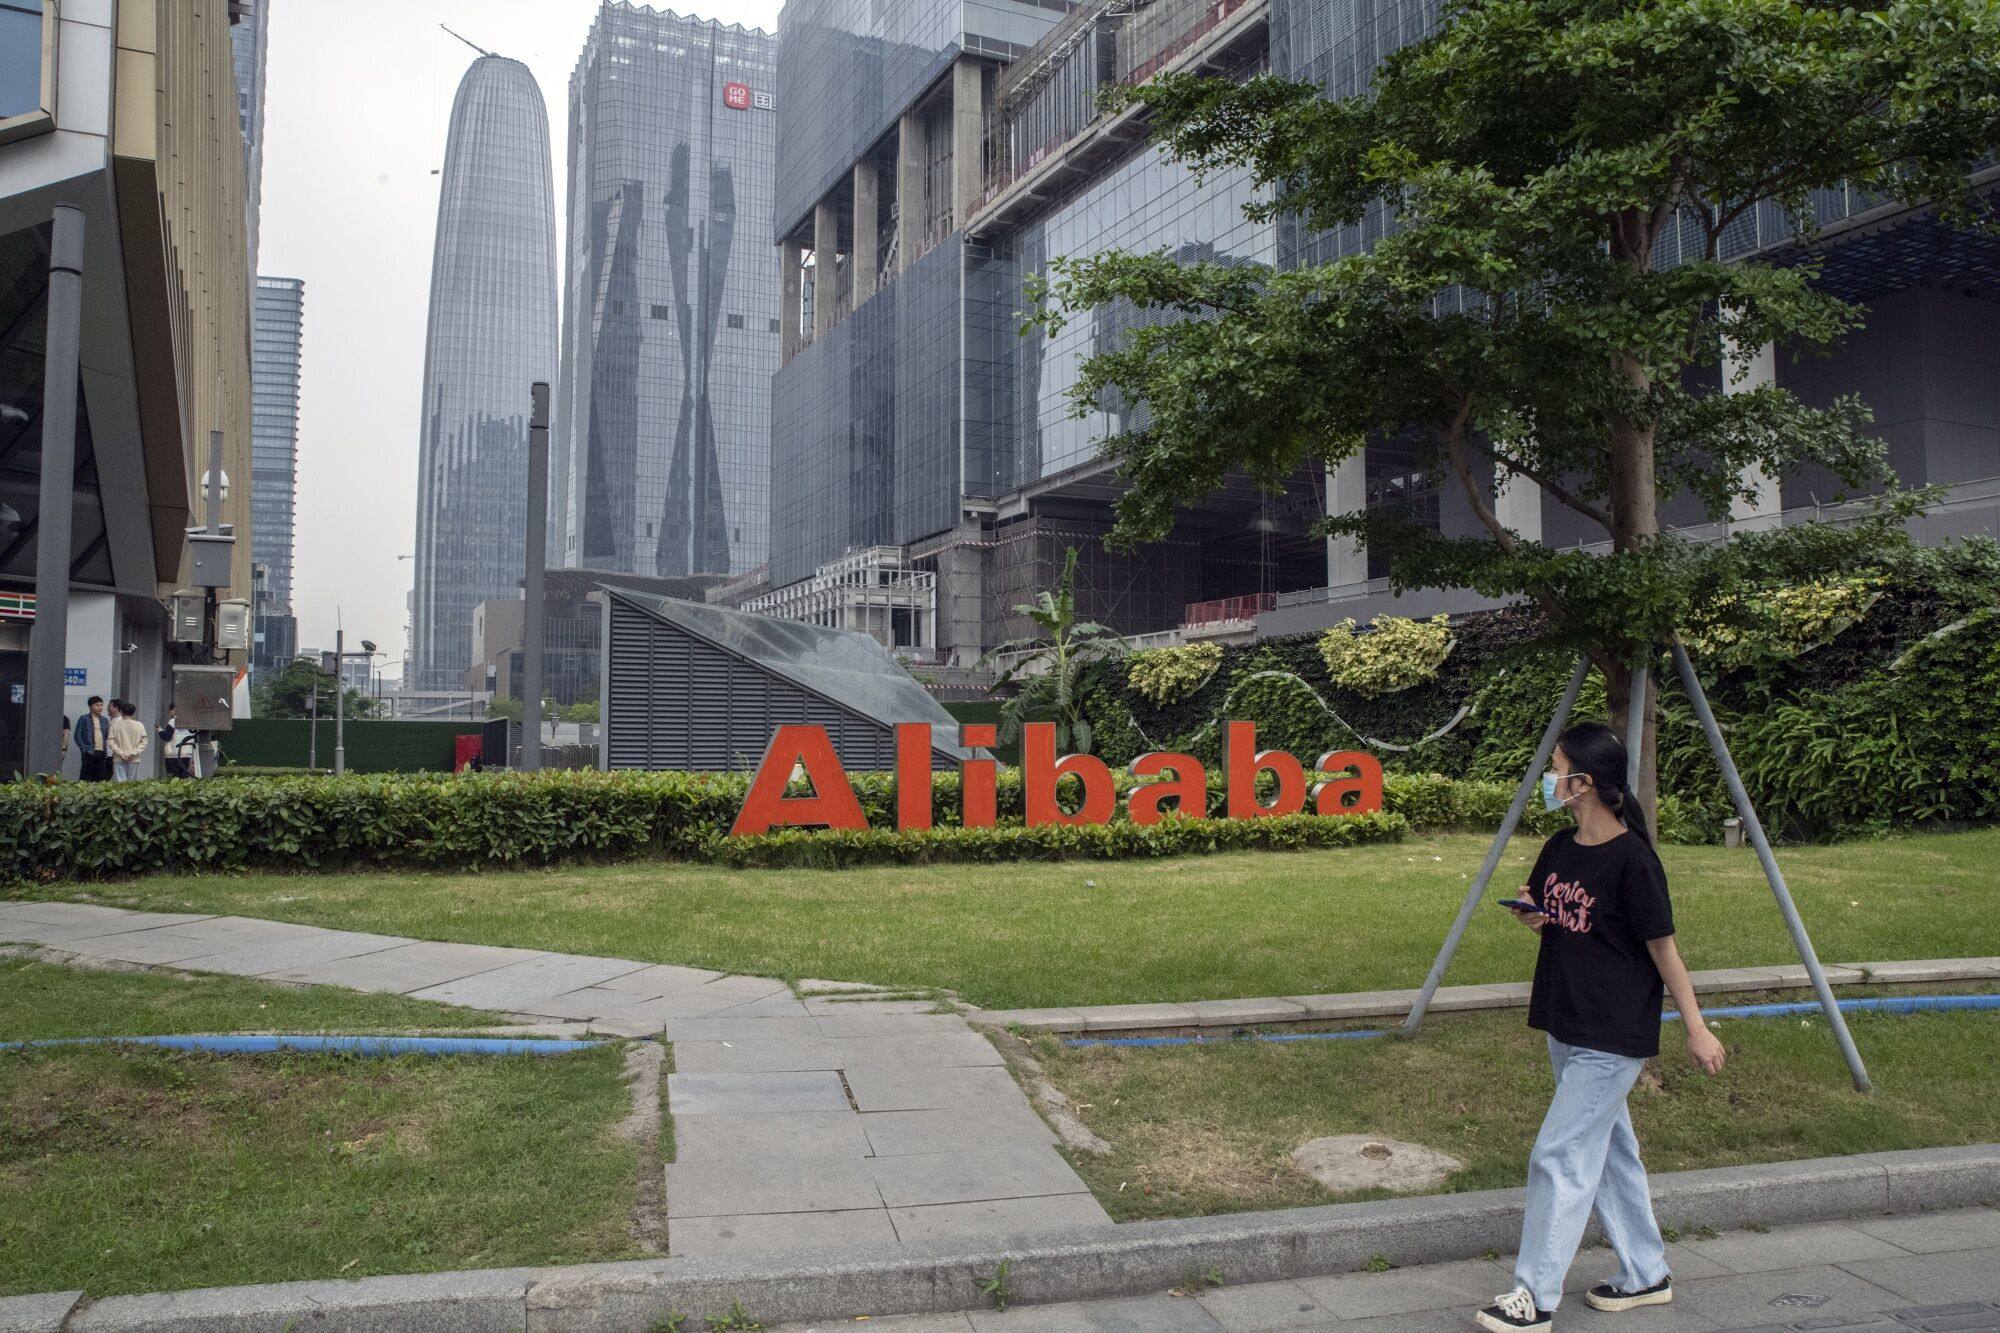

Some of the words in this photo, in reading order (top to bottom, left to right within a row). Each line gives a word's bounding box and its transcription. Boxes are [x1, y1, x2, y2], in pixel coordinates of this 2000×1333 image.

[729, 87, 746, 96] GO
[729, 95, 745, 105] ME
[754, 91, 777, 111] 国
[730, 720, 1383, 837] Alibaba
